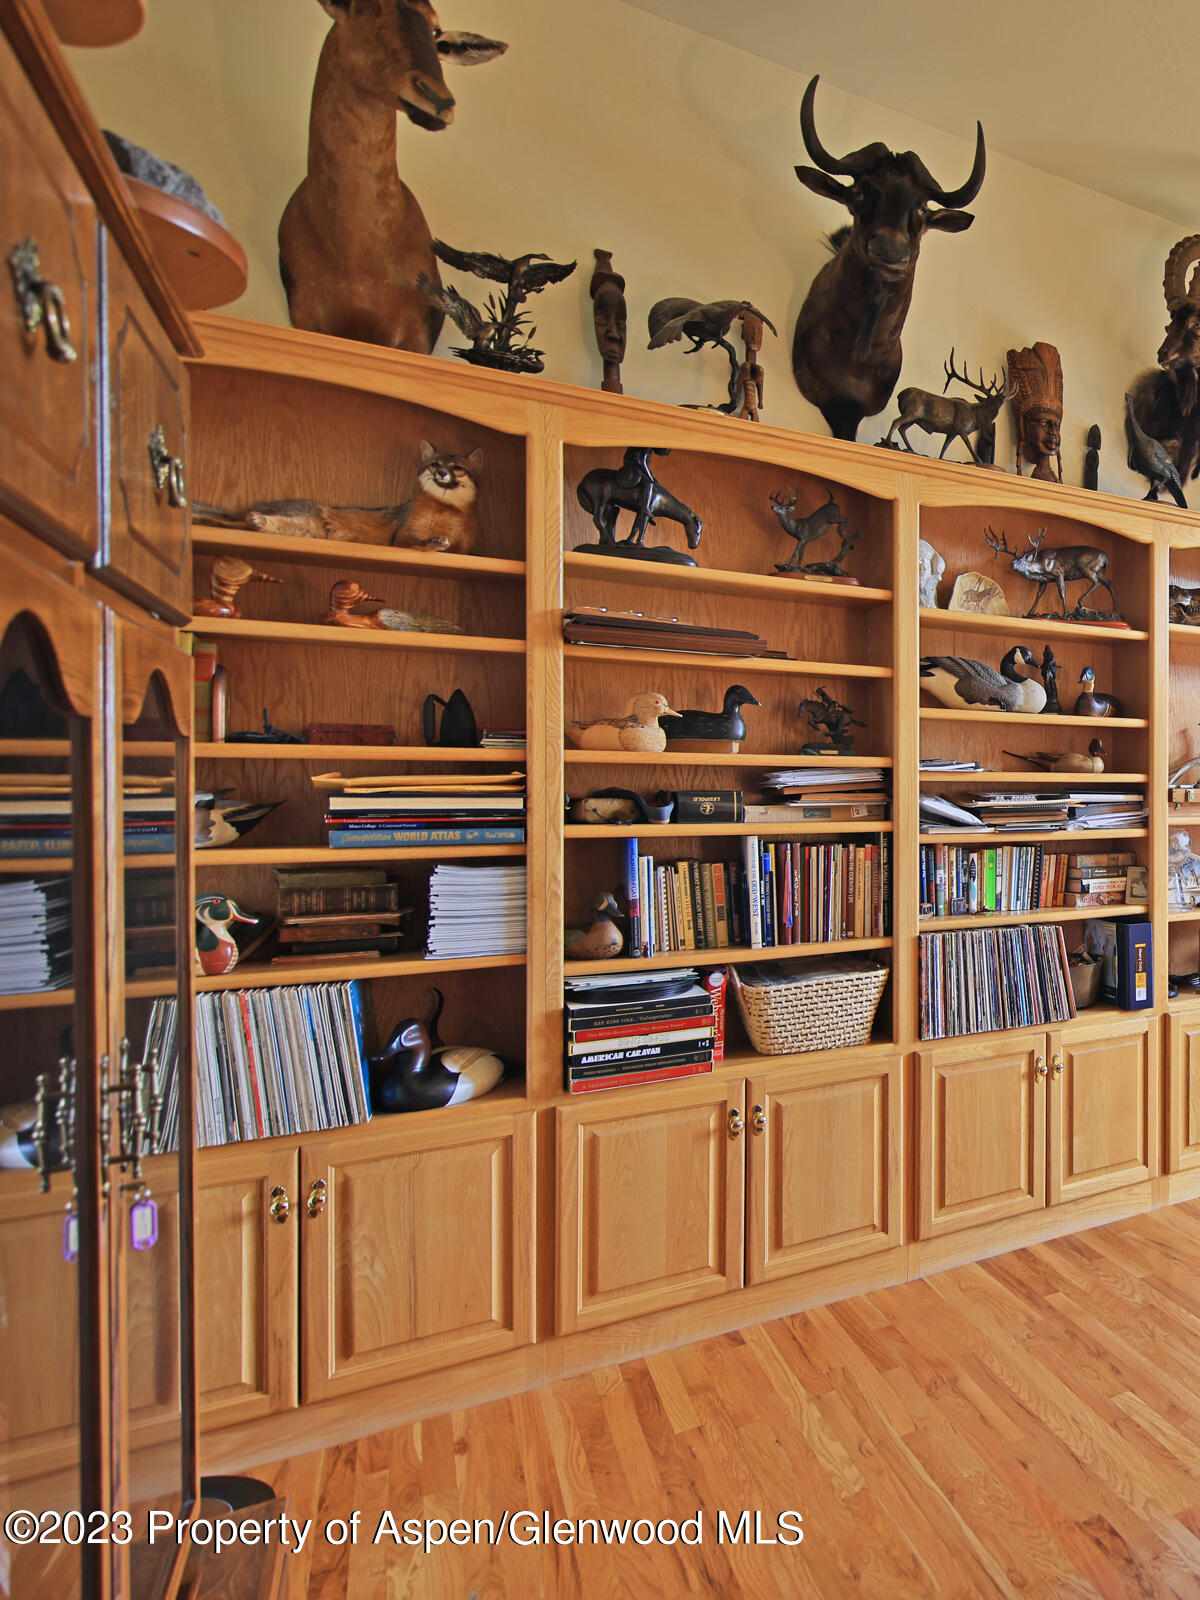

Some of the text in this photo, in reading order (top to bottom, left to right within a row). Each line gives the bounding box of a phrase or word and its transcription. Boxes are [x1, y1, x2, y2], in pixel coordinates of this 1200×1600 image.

[393, 831, 428, 842] WORLD
[430, 831, 461, 841] ATLAS
[581, 1046, 661, 1065] AMERICAN CARAVAN
